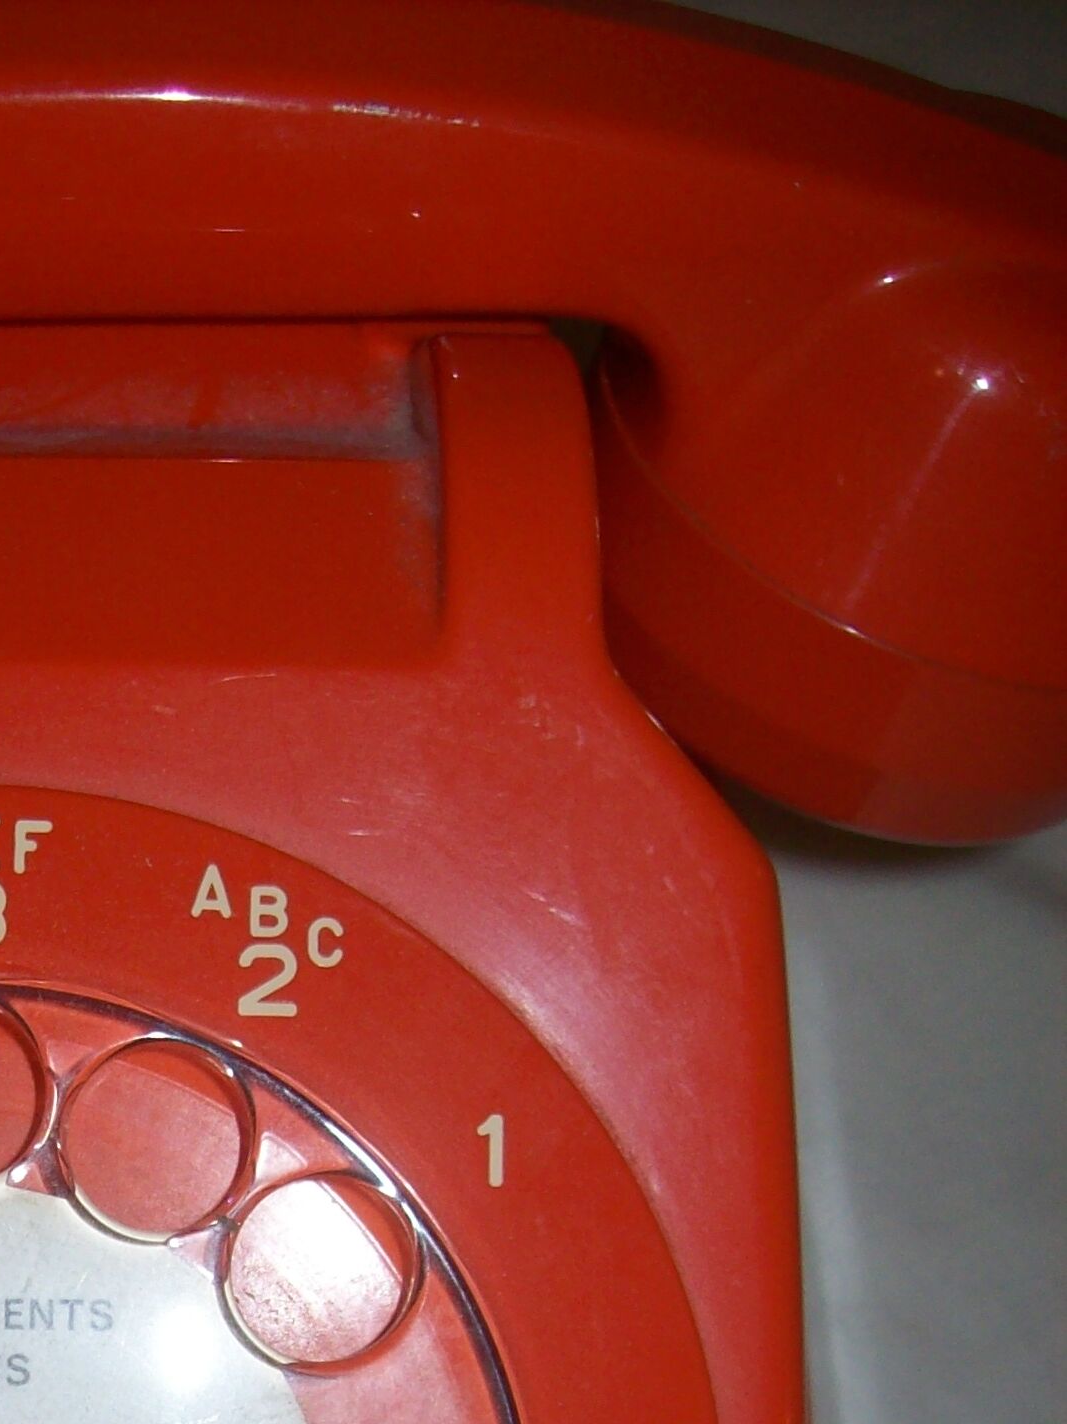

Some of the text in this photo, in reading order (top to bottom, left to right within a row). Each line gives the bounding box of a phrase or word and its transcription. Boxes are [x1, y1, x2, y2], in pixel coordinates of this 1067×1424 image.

[190, 862, 345, 969] ABC
[236, 942, 299, 1018] 2
[475, 1113, 505, 1189] 1
